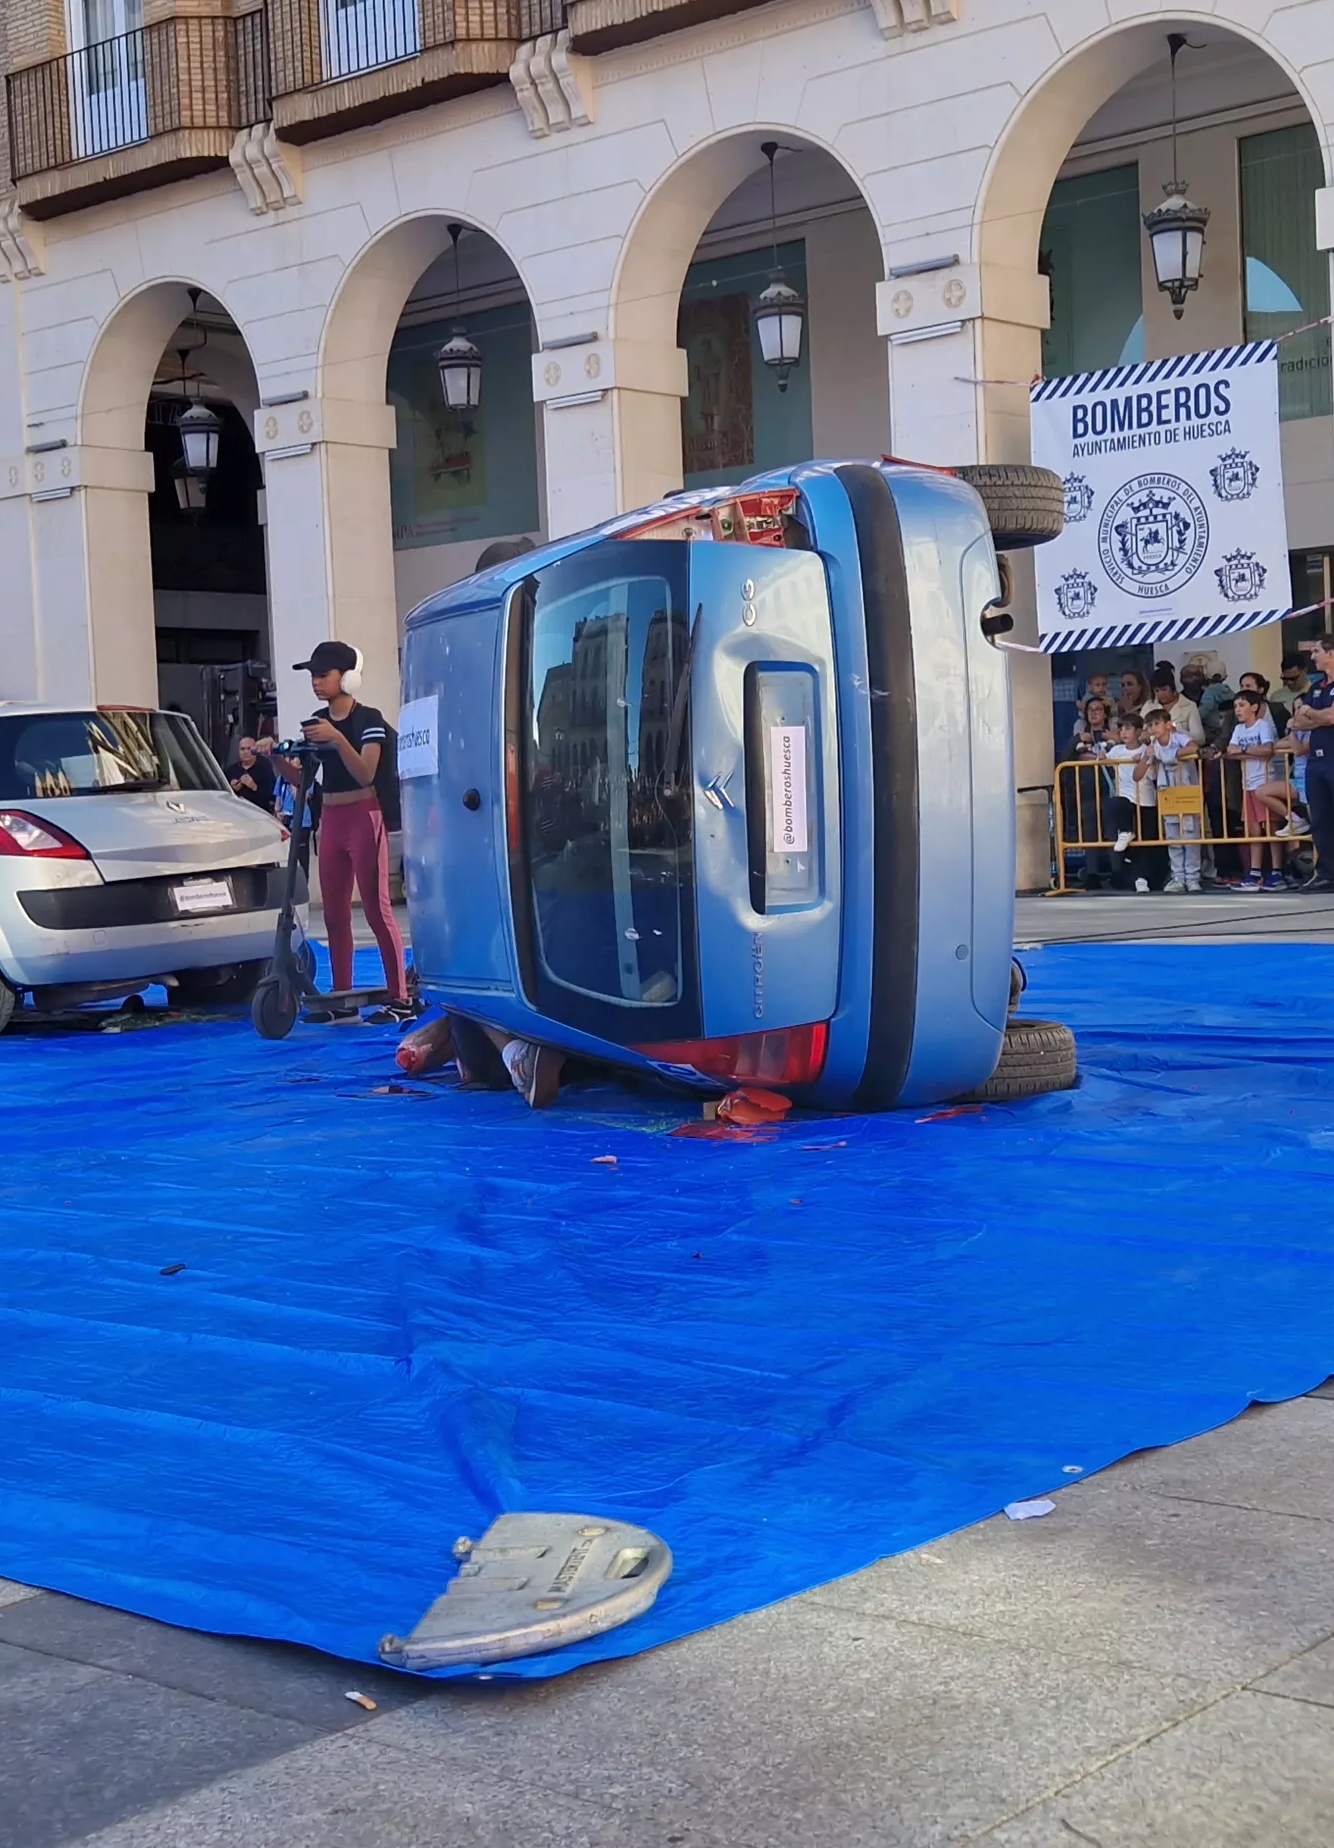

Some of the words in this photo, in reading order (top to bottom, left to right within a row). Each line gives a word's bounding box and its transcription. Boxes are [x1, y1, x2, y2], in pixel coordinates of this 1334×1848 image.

[1072, 379, 1231, 440] BOMBEROS
[1072, 430, 1161, 459] AYUNTAMIENTO
[1164, 427, 1180, 445] DE
[1183, 419, 1232, 441] HUESCA
[1124, 484, 1135, 497] DE
[1137, 476, 1182, 491] BOMBEROS
[1182, 488, 1195, 504] DEL
[1101, 496, 1124, 544] MUNICIPAL
[1185, 506, 1206, 575] AYUNTAMIENTO
[1101, 548, 1126, 585] SERVICIO
[1137, 583, 1170, 595] HUESCA
[783, 735, 795, 845] @bomberoshuesca
